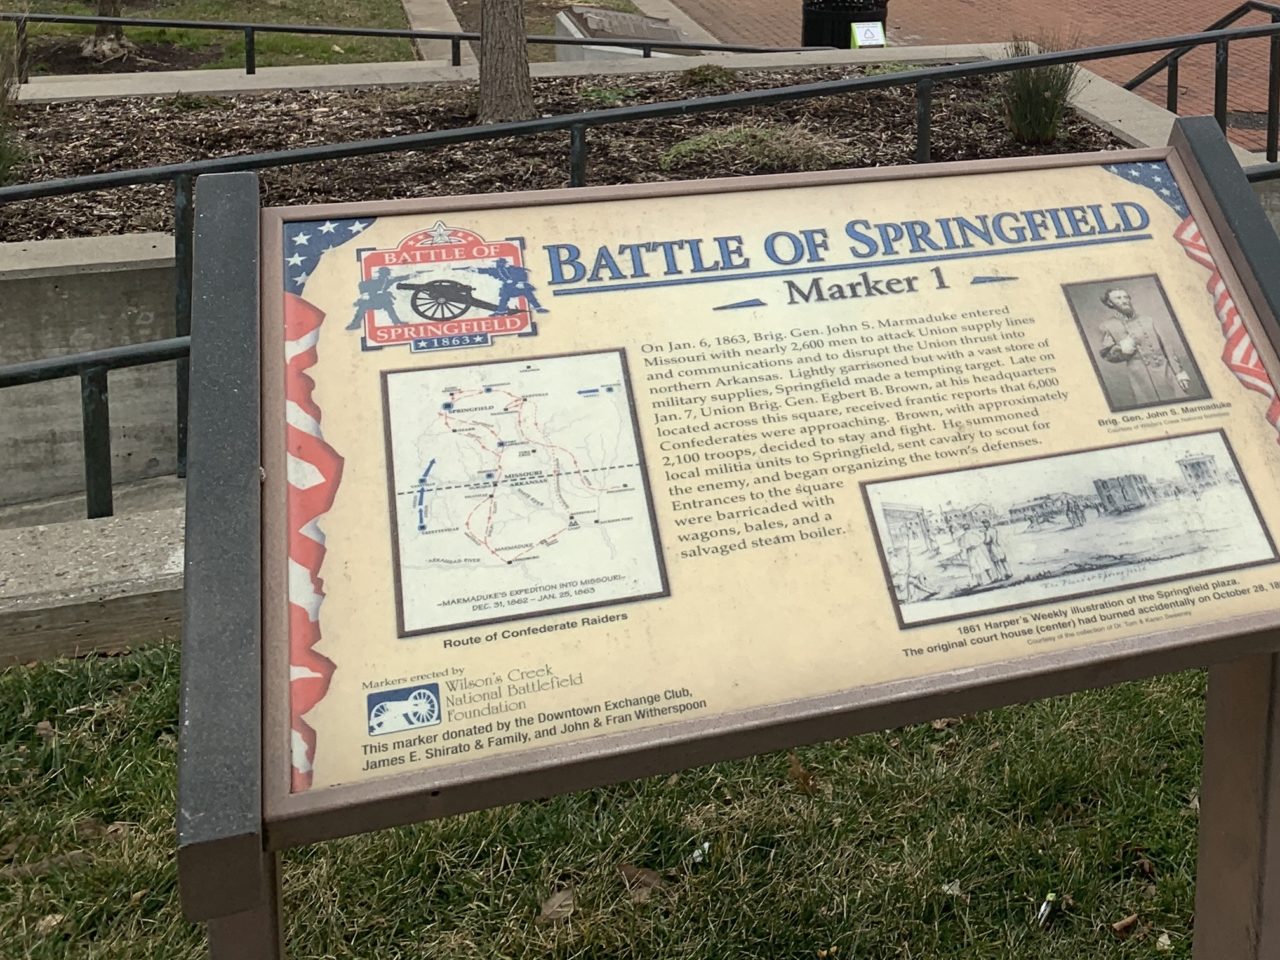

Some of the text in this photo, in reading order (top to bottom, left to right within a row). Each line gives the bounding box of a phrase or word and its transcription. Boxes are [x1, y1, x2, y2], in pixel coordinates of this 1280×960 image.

[384, 244, 500, 264] BATTLE OF
[542, 235, 750, 286] BATTLE
[845, 201, 1151, 259] SPRINGFIELD
[783, 266, 950, 305] Marker 1
[376, 317, 521, 341] SPRINGFIELD
[432, 335, 471, 349] 1863
[641, 305, 1010, 353] On Jan. 6, 1863, Brig. Gen. John S. Marmaduke entered
[643, 352, 707, 367] Missouri
[710, 348, 741, 360] with
[745, 343, 787, 356] nearly
[791, 339, 825, 352] 2,600
[828, 338, 858, 347] men
[877, 329, 915, 342] attack
[918, 326, 958, 337] Union
[961, 319, 1002, 333] supply
[1005, 318, 1035, 326] lines
[647, 331, 1025, 381] and communications and to disrupt the Union thrust into
[649, 381, 711, 395] northern
[715, 374, 783, 387] Arkansas.
[789, 365, 835, 380] Lightly
[839, 356, 909, 375] garrisoned
[911, 354, 934, 364] but
[936, 349, 965, 360] with
[977, 346, 1002, 355] vast
[1005, 343, 1034, 352] store
[1037, 338, 1049, 348] of
[652, 396, 707, 409] military
[710, 388, 773, 403] supplies,
[775, 376, 851, 396] Springfield
[854, 372, 890, 385] made
[904, 365, 963, 378] tempting
[965, 359, 1005, 371] target.
[1009, 355, 1036, 365] Late
[1039, 353, 1055, 361] on
[668, 438, 1042, 496] the enemy, and began organizing the town's defenses.
[674, 495, 835, 526] were barricaded with
[677, 512, 832, 543] wagons, bales, and a
[680, 526, 846, 559] salvaged steam boiler.
[902, 648, 924, 657] The
[926, 638, 968, 653] original
[970, 633, 999, 645] court
[1000, 628, 1034, 640] house
[1035, 619, 1076, 635] (center)
[1077, 615, 1098, 625] had
[1098, 608, 1136, 622] burned
[1138, 597, 1195, 615] accidentally
[1198, 595, 1211, 603] on
[1212, 588, 1250, 600] October
[1252, 584, 1268, 593] 28,
[957, 579, 1240, 635] 1861 Harper's Weekly illustration of the Springfield plaza.
[443, 613, 628, 649] Route of Confederate Raiders
[362, 667, 465, 690] Markers erected by
[444, 664, 553, 692] Wilson's Creek
[446, 672, 583, 708] National Battlefield
[362, 688, 693, 755] This marker donated by the Downtown Exchange Club,
[447, 701, 527, 723] Foundation
[362, 755, 406, 771] James
[409, 751, 421, 762] E.
[474, 739, 484, 750] &
[487, 732, 531, 748] Family,
[534, 725, 557, 739] and
[560, 721, 590, 734] John
[593, 717, 602, 728] &
[605, 714, 632, 725] Fran
[634, 700, 707, 720] Witherspoon
